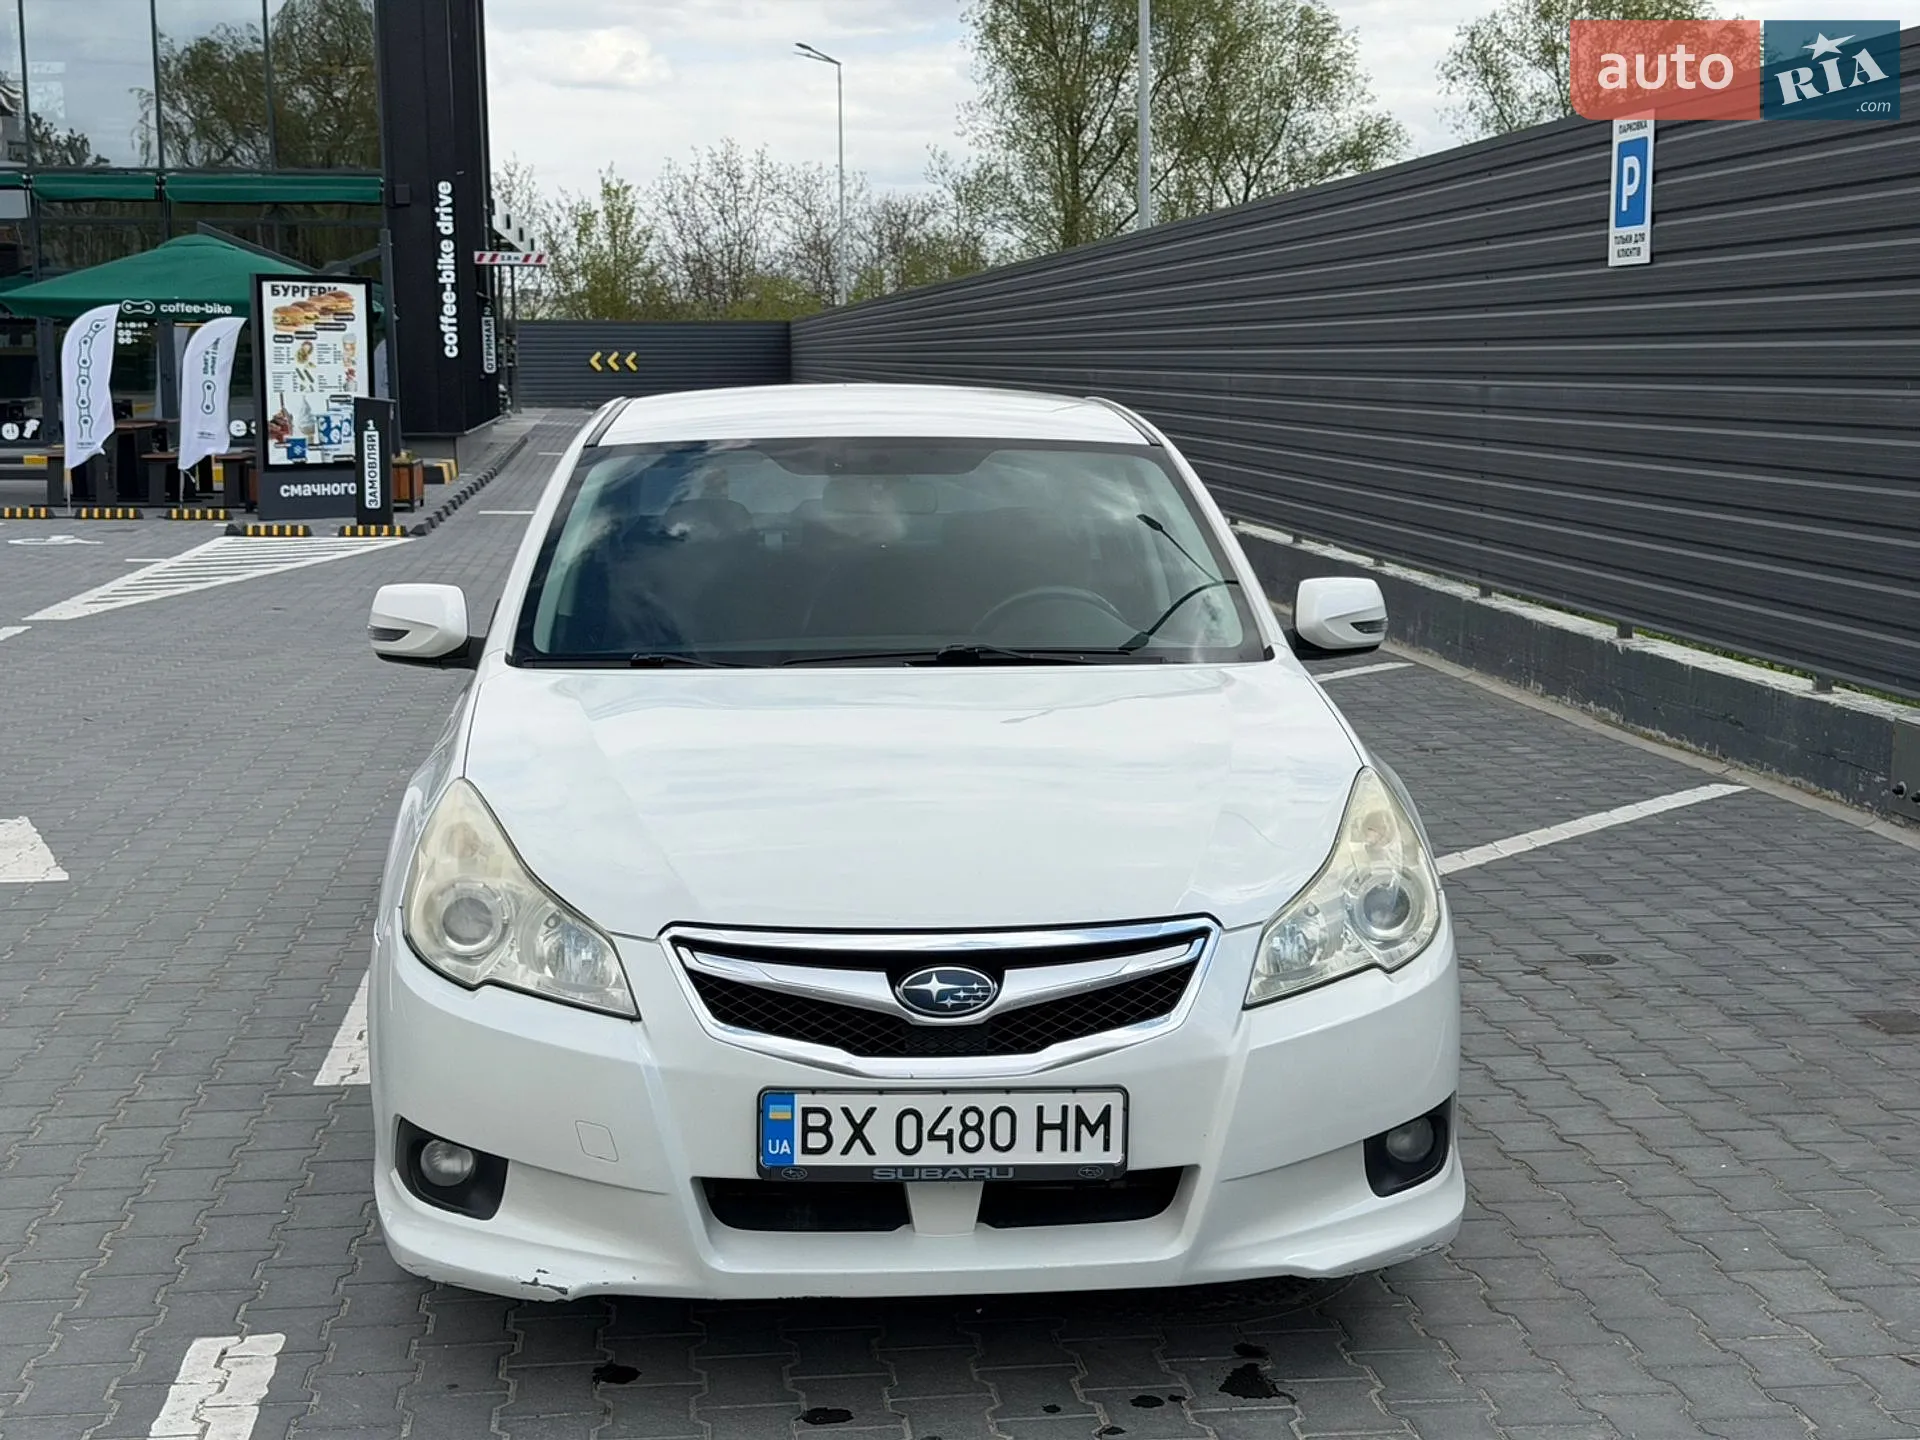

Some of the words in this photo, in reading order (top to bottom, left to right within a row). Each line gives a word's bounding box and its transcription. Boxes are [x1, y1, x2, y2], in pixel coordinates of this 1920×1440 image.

[434, 180, 455, 235] drive
[1621, 155, 1641, 212] P
[160, 303, 232, 314] coffee-bike
[437, 239, 459, 358] coffee-bike
[280, 483, 357, 497] смачного
[366, 433, 379, 506] ЗАМОВЛЯЙ
[768, 1139, 791, 1155] UA
[895, 1105, 1017, 1156] 0480
[872, 1167, 1015, 1180] SUBARU
